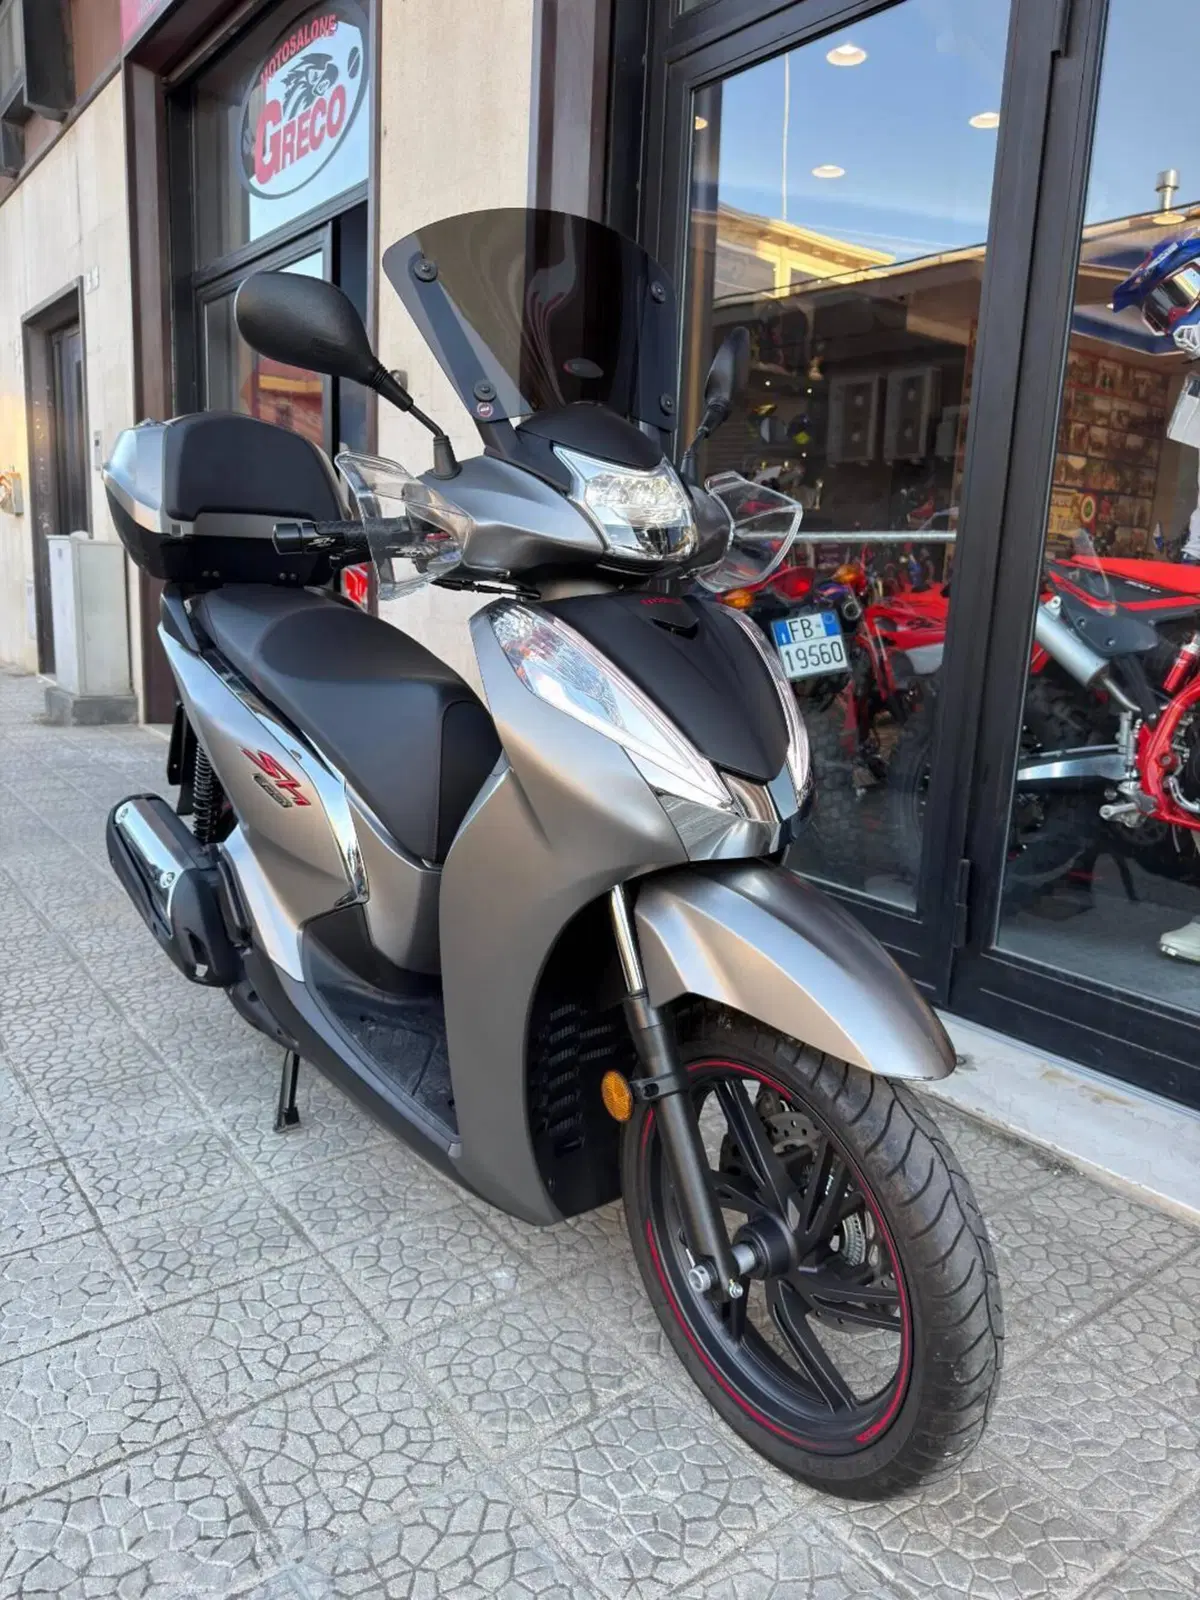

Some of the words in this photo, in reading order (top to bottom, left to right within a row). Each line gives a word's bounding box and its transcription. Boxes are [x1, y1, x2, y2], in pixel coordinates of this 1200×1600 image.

[260, 14, 338, 87] MOTOSALONE
[254, 84, 346, 185] GRECO
[784, 641, 844, 672] 19560
[788, 618, 814, 641] FB
[240, 748, 312, 807] SH
